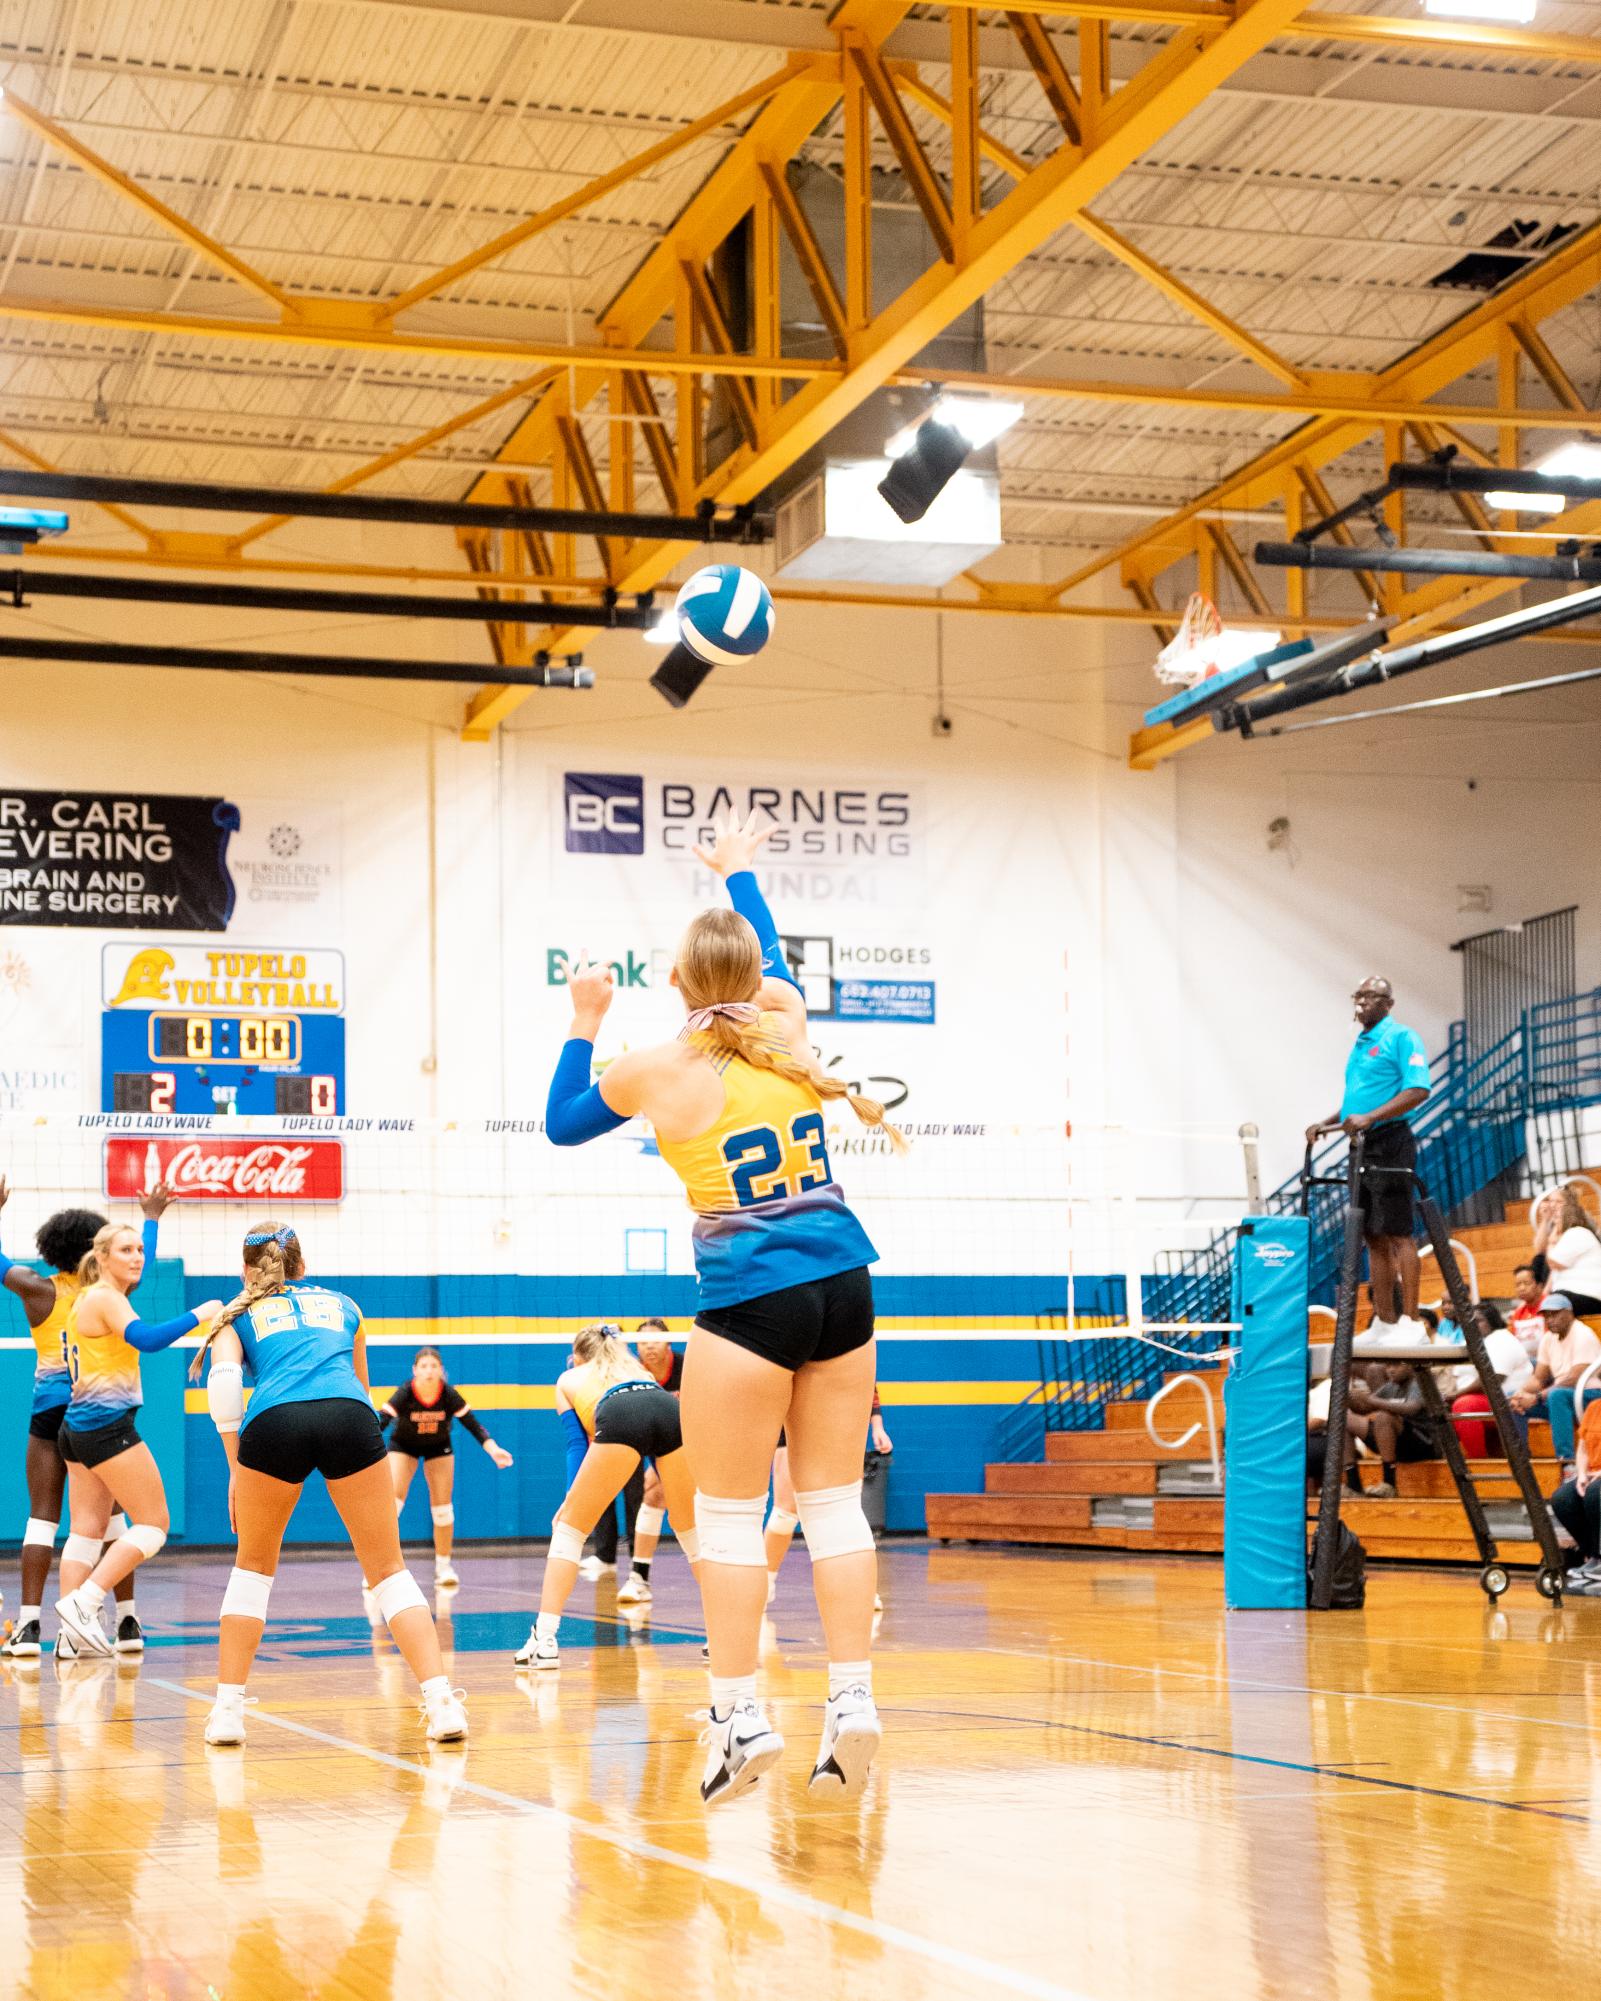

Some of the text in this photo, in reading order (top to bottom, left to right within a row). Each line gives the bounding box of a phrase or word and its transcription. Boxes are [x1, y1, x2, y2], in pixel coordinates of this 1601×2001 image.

[0, 797, 166, 832] R. CARL
[569, 794, 641, 833] BC
[662, 784, 910, 826] BARNES
[0, 829, 173, 863] EVERING
[662, 826, 911, 857] CRSSING
[86, 871, 146, 892] AND
[49, 892, 180, 916] SURGERY
[207, 952, 307, 979] TUPELO
[840, 947, 931, 964] HODGES
[174, 980, 339, 1008] VOLLEYBALL
[186, 1018, 291, 1060] 0:00
[150, 1073, 176, 1114] 2
[212, 1086, 237, 1104] SET
[311, 1076, 336, 1116] 0
[78, 1115, 131, 1128] TUPELO
[281, 1118, 416, 1131] TUPELO LADY WAVE
[485, 1120, 535, 1133] TUPELO
[917, 1123, 949, 1136] LADY
[953, 1124, 986, 1136] WAVE
[165, 1144, 313, 1194] Coca-Cola
[716, 1109, 833, 1208] 23
